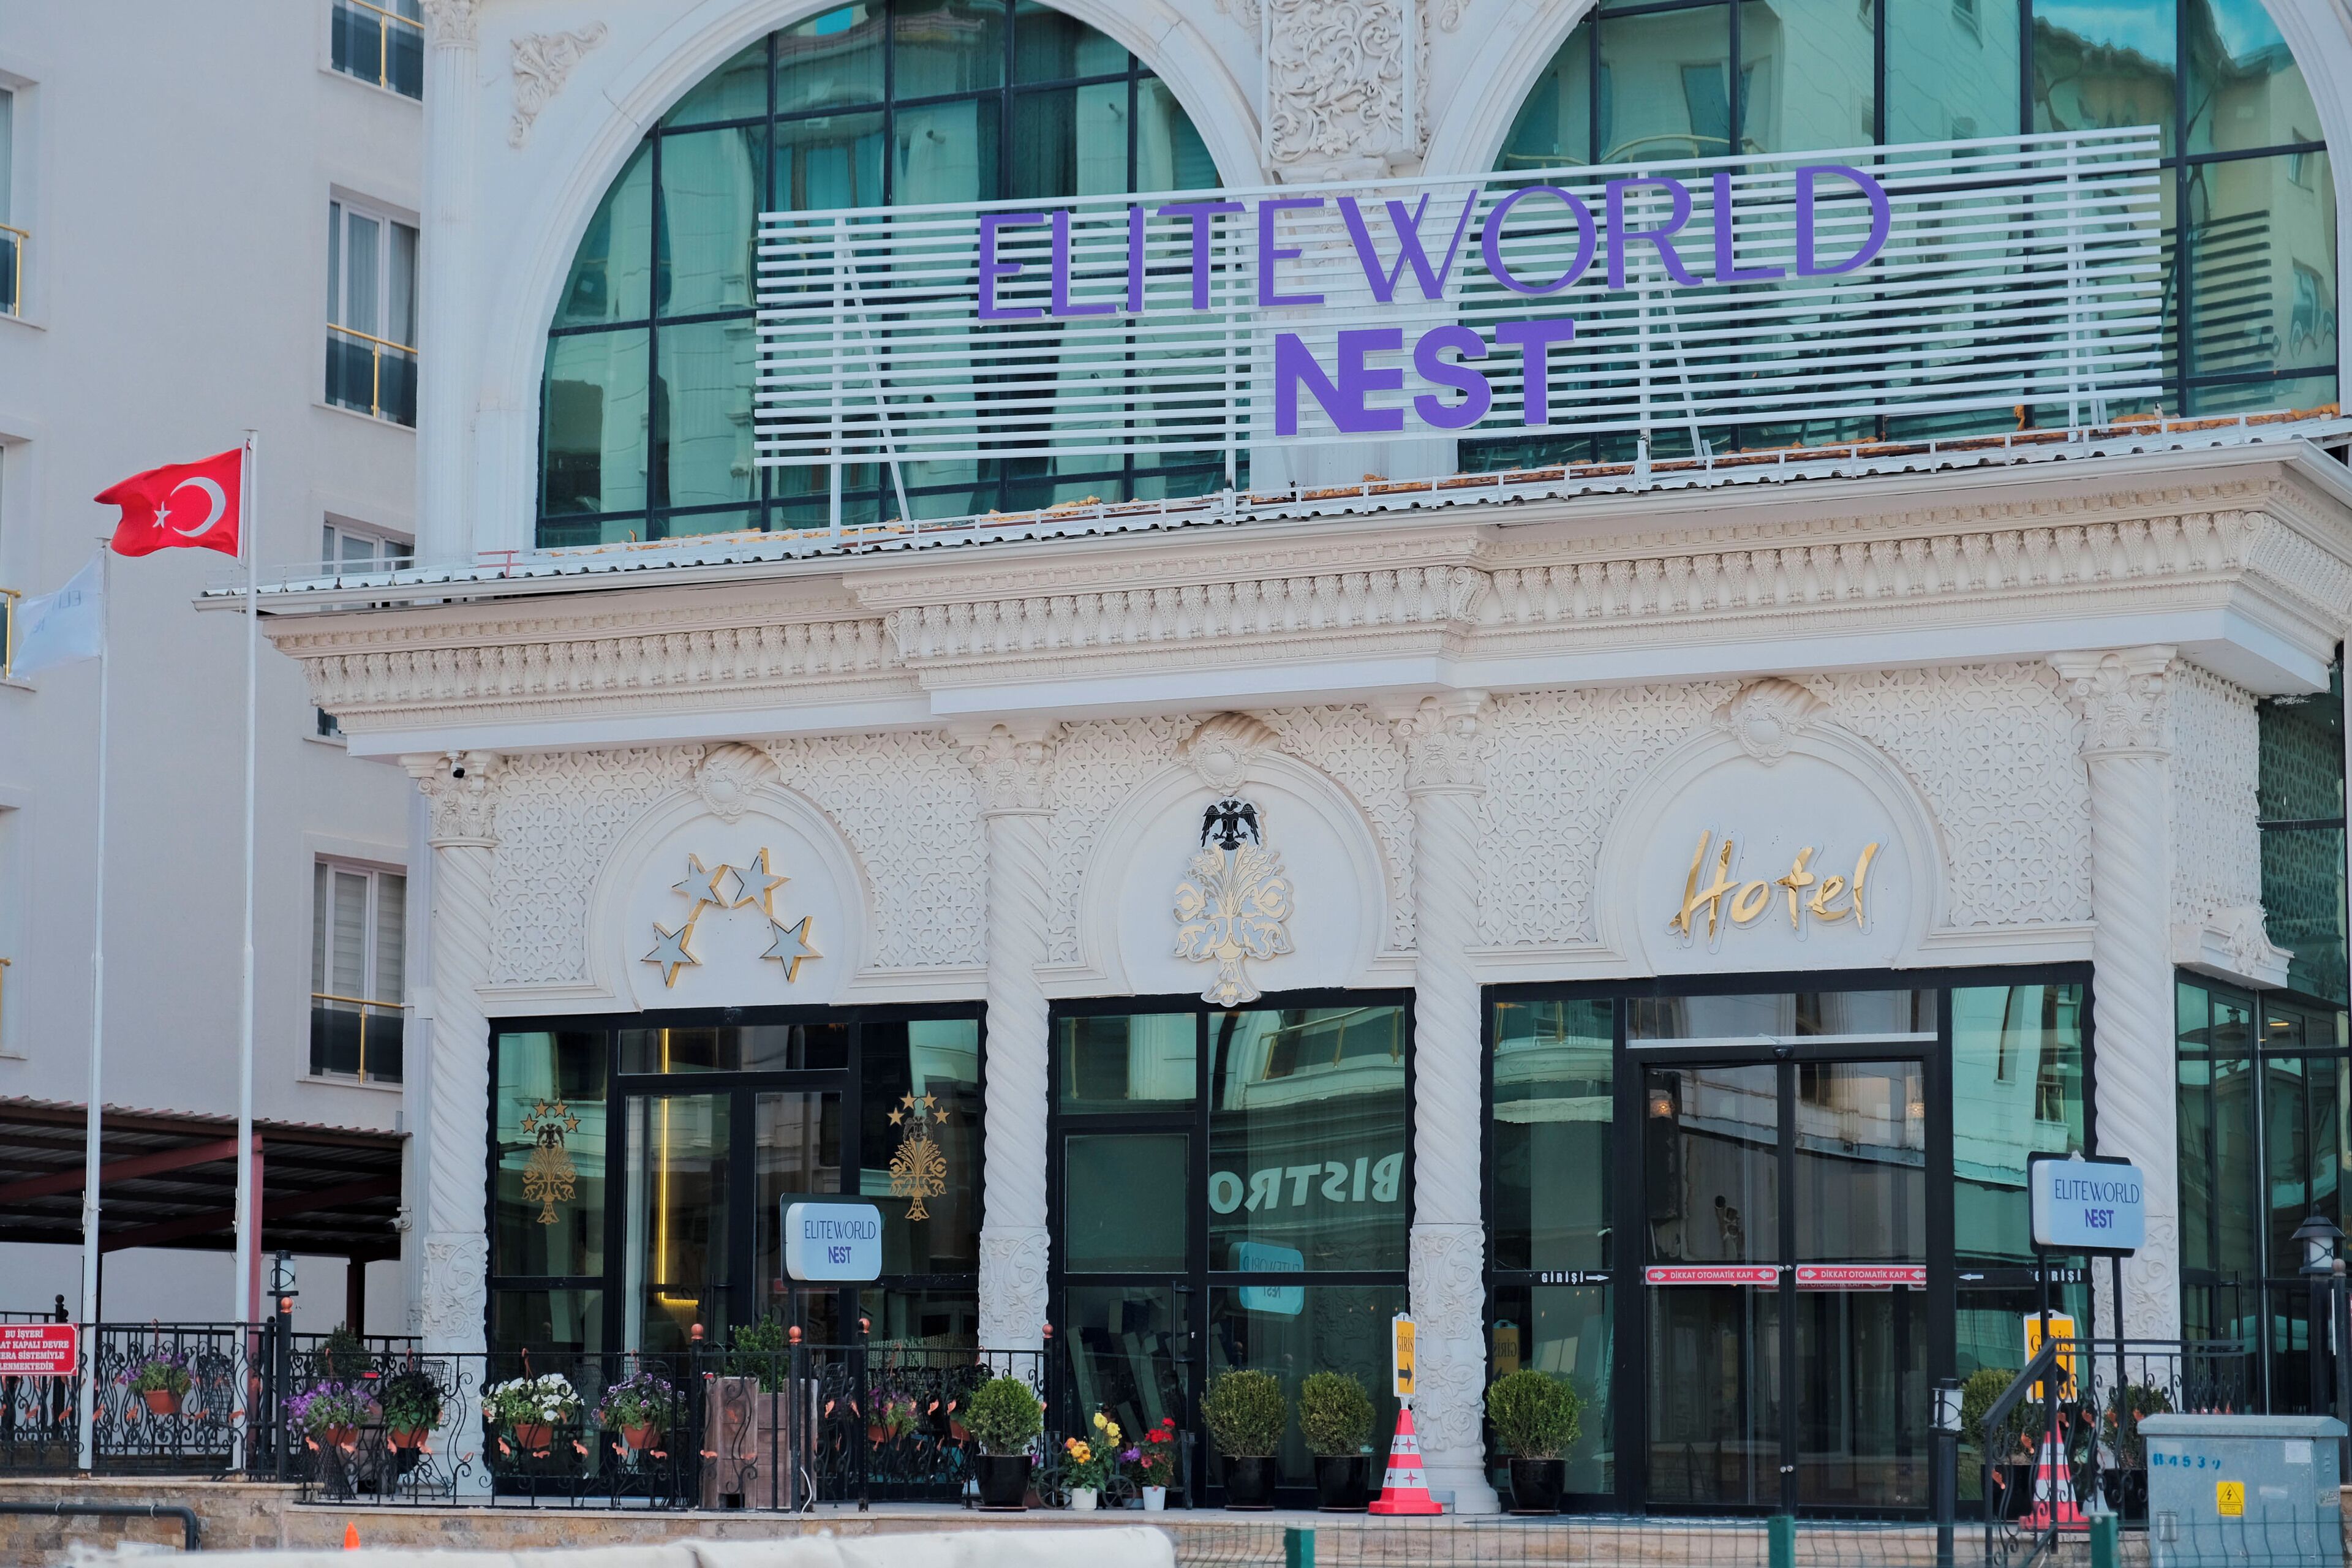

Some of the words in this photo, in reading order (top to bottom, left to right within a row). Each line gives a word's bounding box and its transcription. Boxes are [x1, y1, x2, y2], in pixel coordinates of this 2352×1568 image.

[1275, 318, 1575, 436] NEST
[1670, 829, 1880, 944] Hotel
[2055, 1179, 2140, 1204] ELITEWORLD
[2085, 1208, 2114, 1229] NEST
[805, 1220, 876, 1240] ELITEWORLD
[828, 1246, 852, 1264] NEST
[1541, 1270, 1583, 1284] GİRİŞİ
[1821, 1270, 1847, 1278] DİKKAT
[1849, 1270, 1887, 1278] OTOMATİK
[5, 1330, 15, 1338] BU
[17, 1328, 43, 1340] İŞYERİ
[0, 1351, 16, 1360] ERA
[18, 1350, 64, 1360] SİSTEMİYLE
[1396, 1333, 1414, 1357] GİRİŞ
